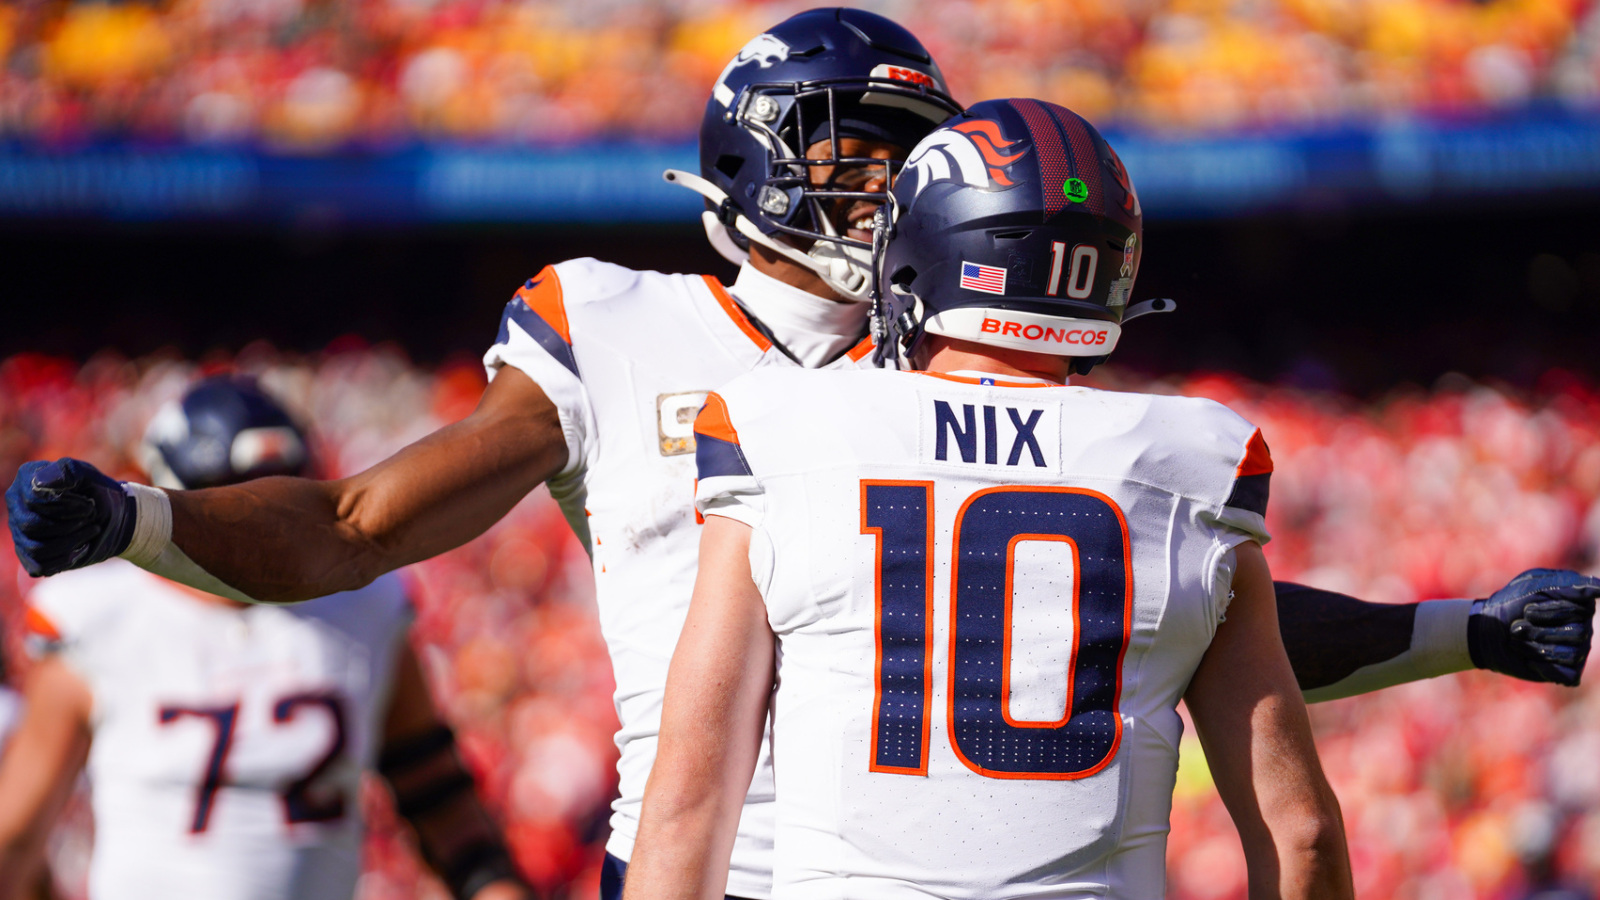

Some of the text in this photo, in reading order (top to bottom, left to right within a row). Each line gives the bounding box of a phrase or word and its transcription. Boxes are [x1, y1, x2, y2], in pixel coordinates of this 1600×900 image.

[1047, 241, 1098, 299] 10
[981, 318, 1108, 346] BRONCOS
[934, 400, 1047, 467] NIX
[860, 479, 1133, 781] 10
[158, 692, 346, 834] 72
